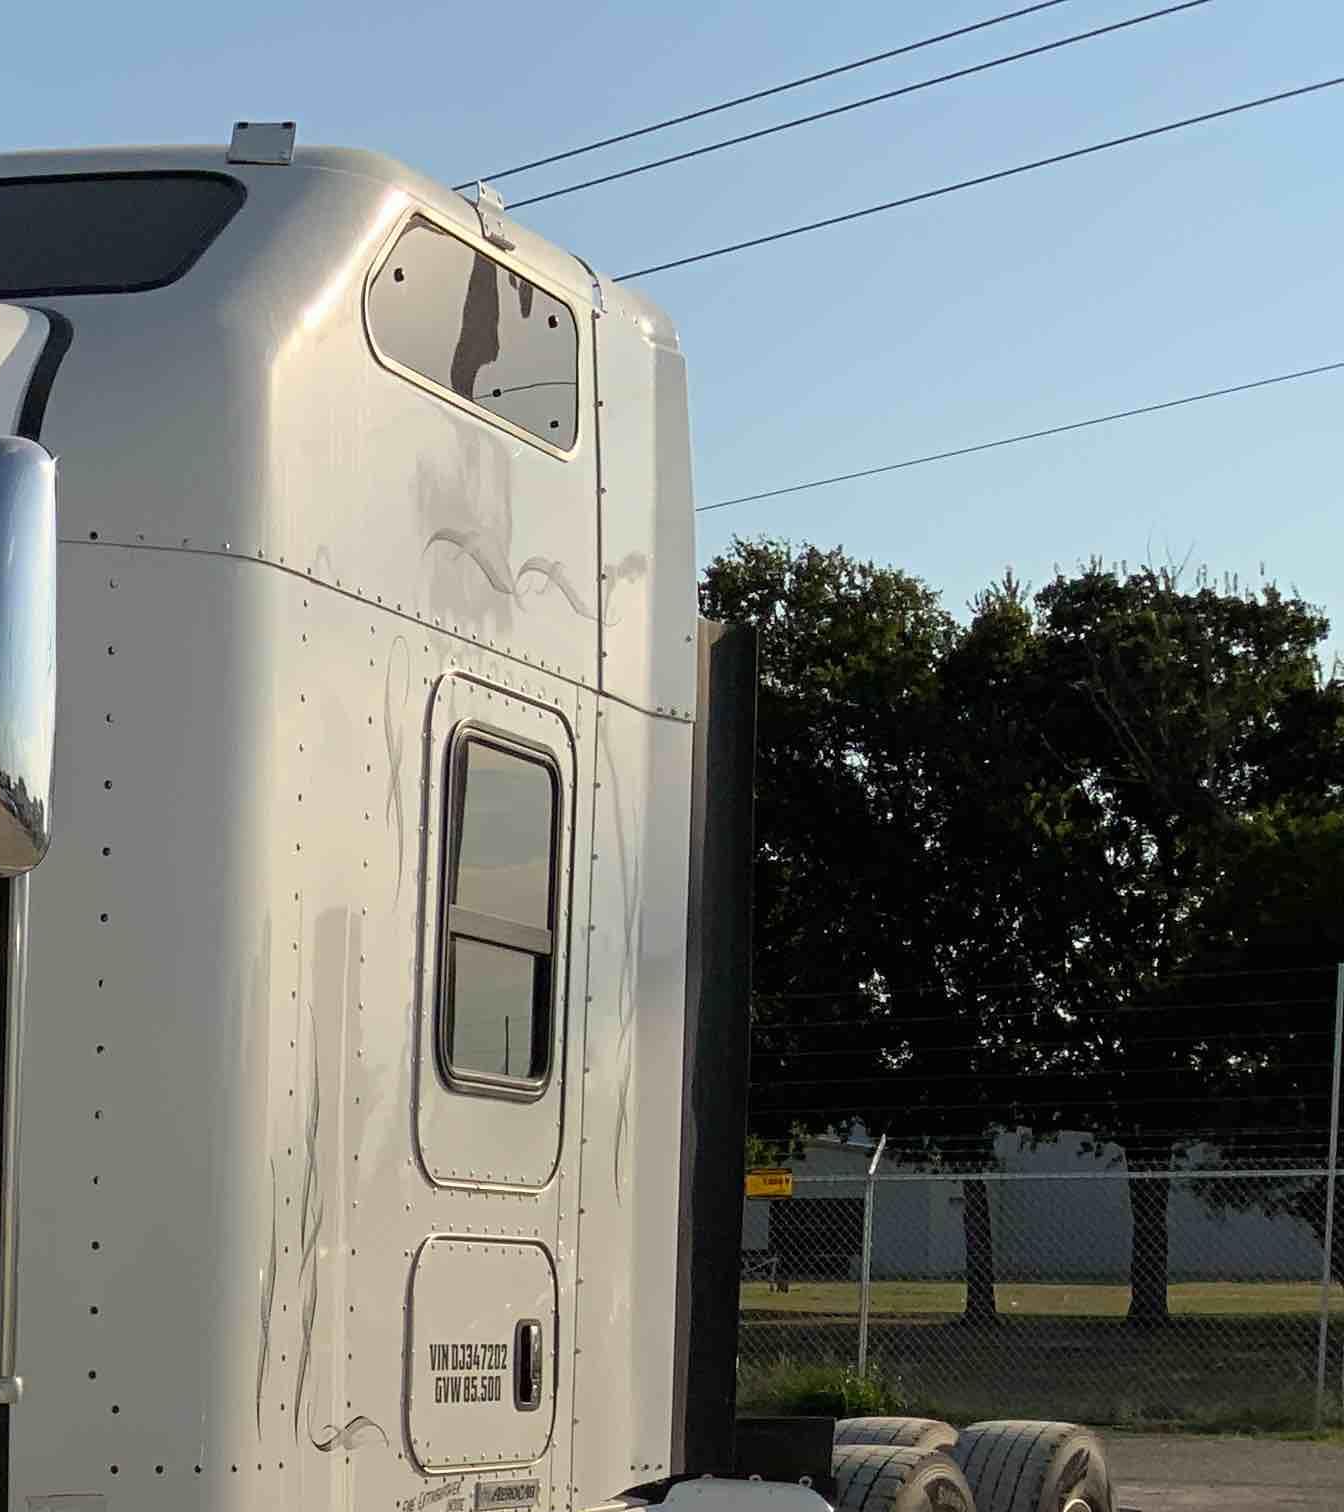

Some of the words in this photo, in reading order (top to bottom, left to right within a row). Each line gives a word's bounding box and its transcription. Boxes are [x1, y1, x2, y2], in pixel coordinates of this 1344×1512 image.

[429, 1343, 449, 1371] VIN
[451, 1343, 507, 1370] DJ347202
[435, 1376, 461, 1403] GVW
